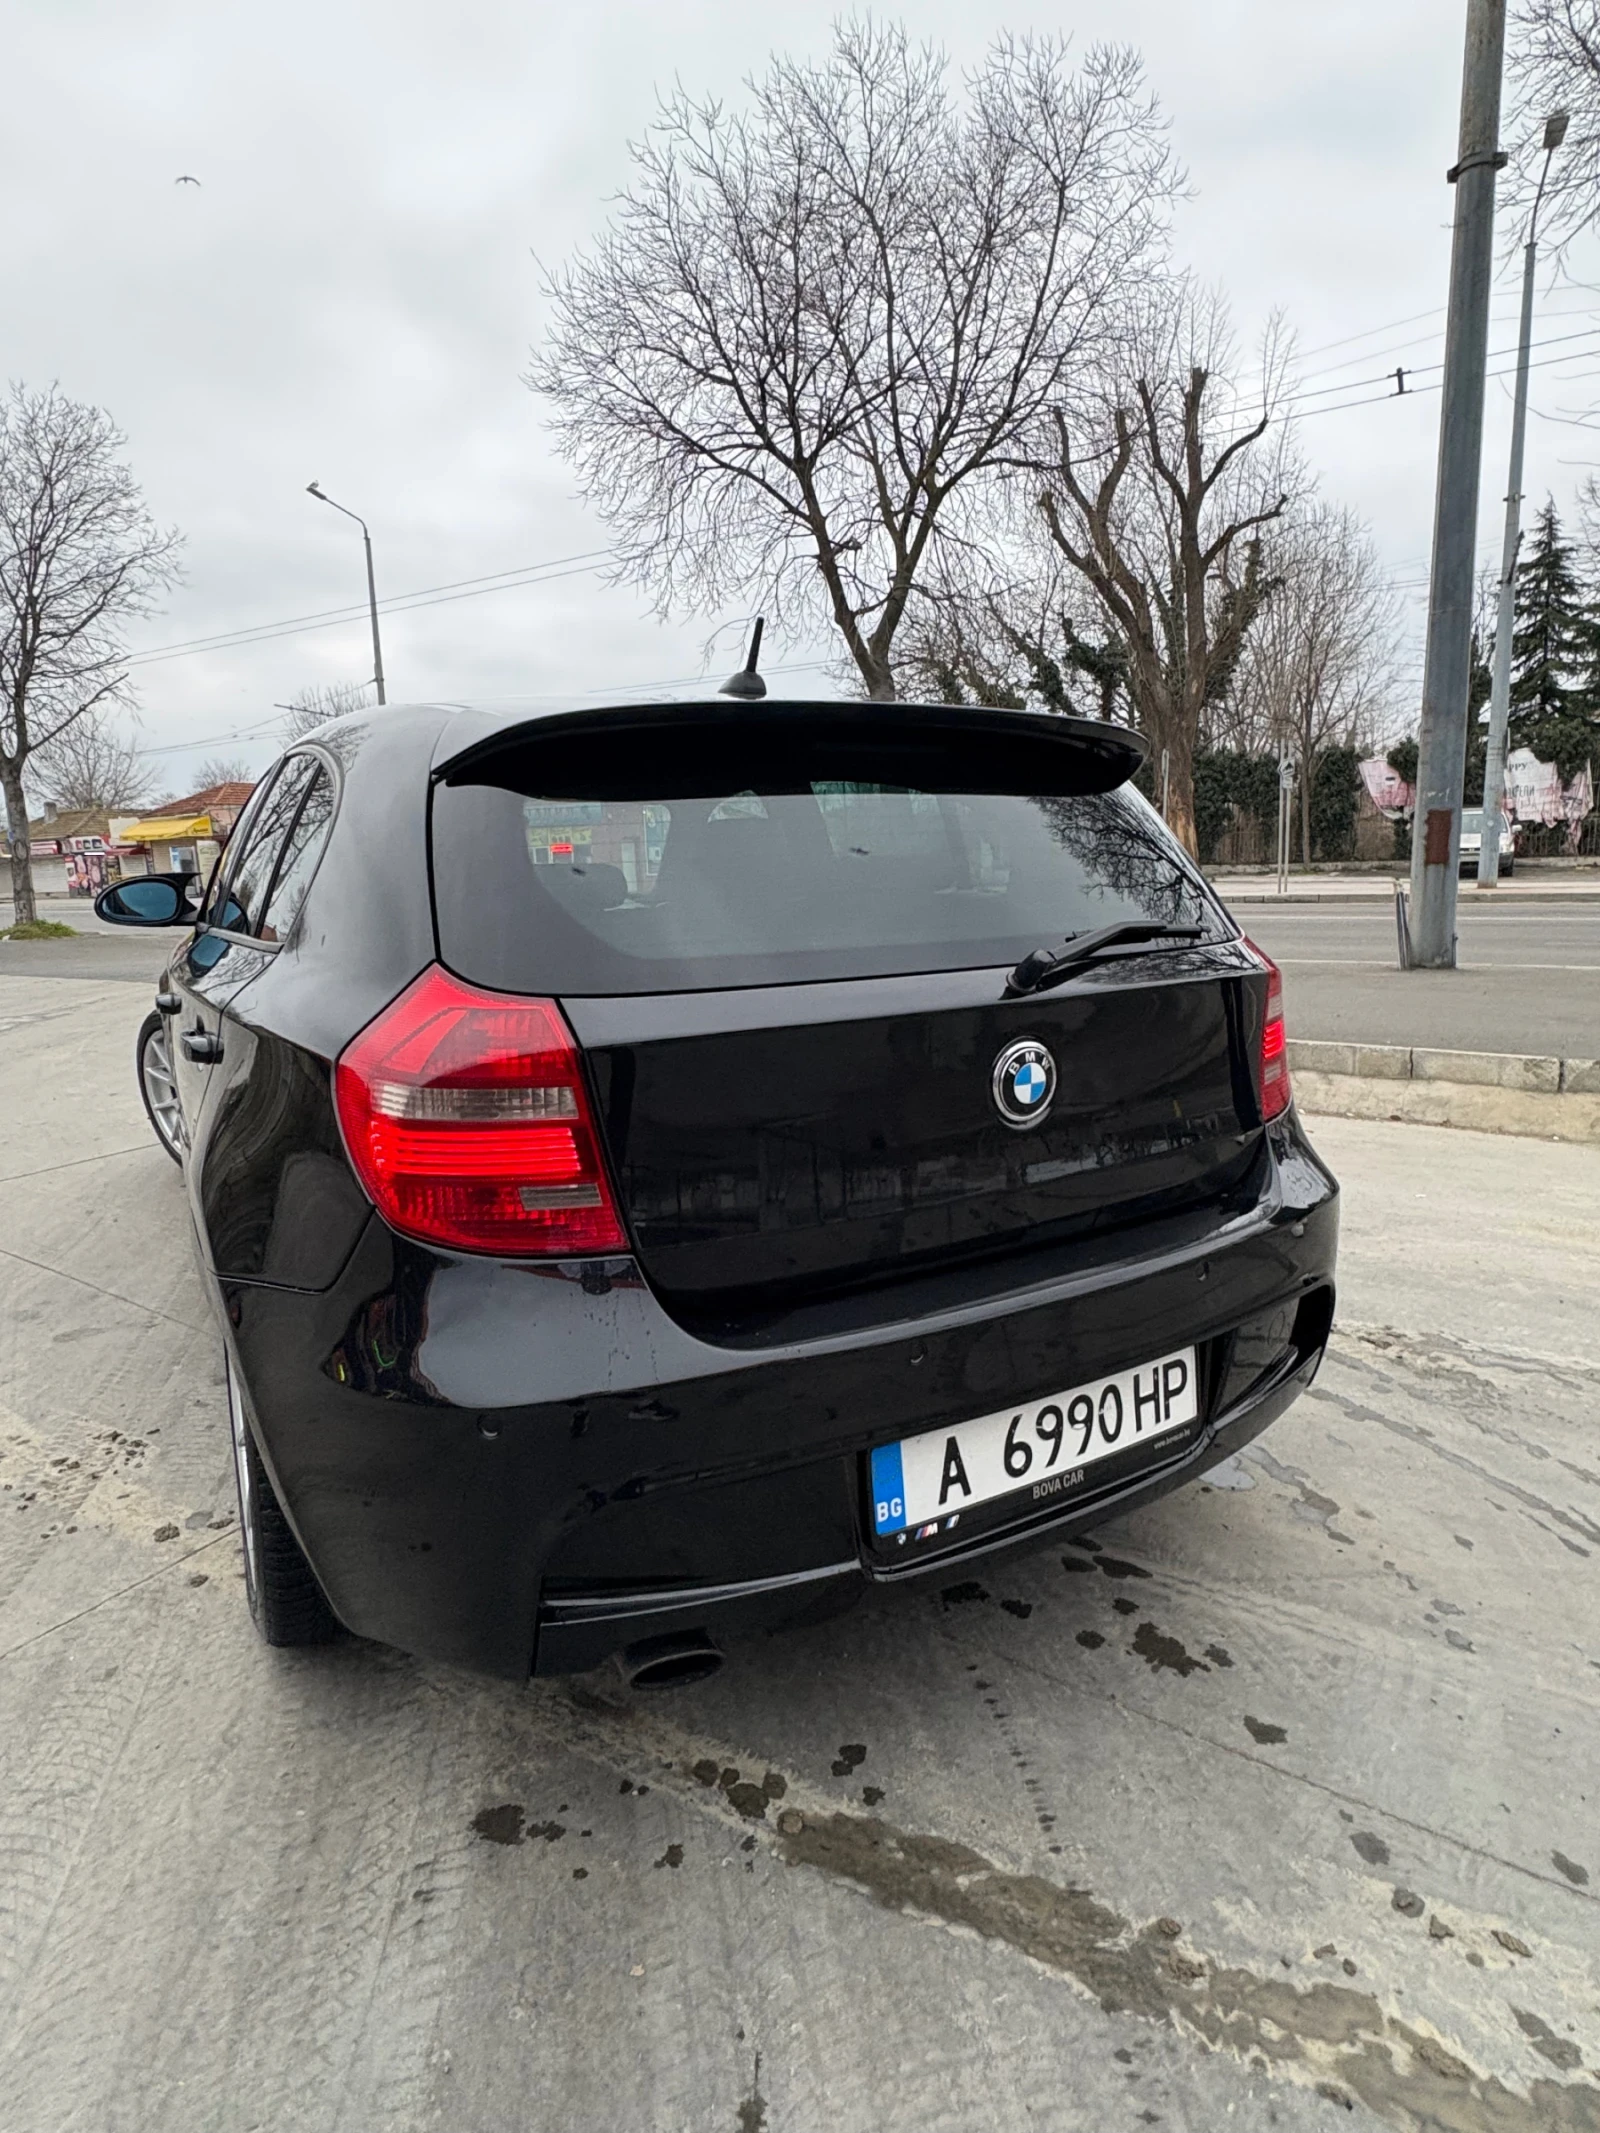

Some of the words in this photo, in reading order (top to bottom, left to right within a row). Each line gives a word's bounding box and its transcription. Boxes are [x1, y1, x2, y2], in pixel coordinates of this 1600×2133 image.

[1008, 1051, 1050, 1076] BMW
[938, 1436, 972, 1505] A
[1003, 1384, 1123, 1478] 6990
[1133, 1358, 1188, 1432] HP
[1032, 1477, 1062, 1500] BOVA
[1062, 1469, 1085, 1488] CAR
[876, 1497, 902, 1523] BG
